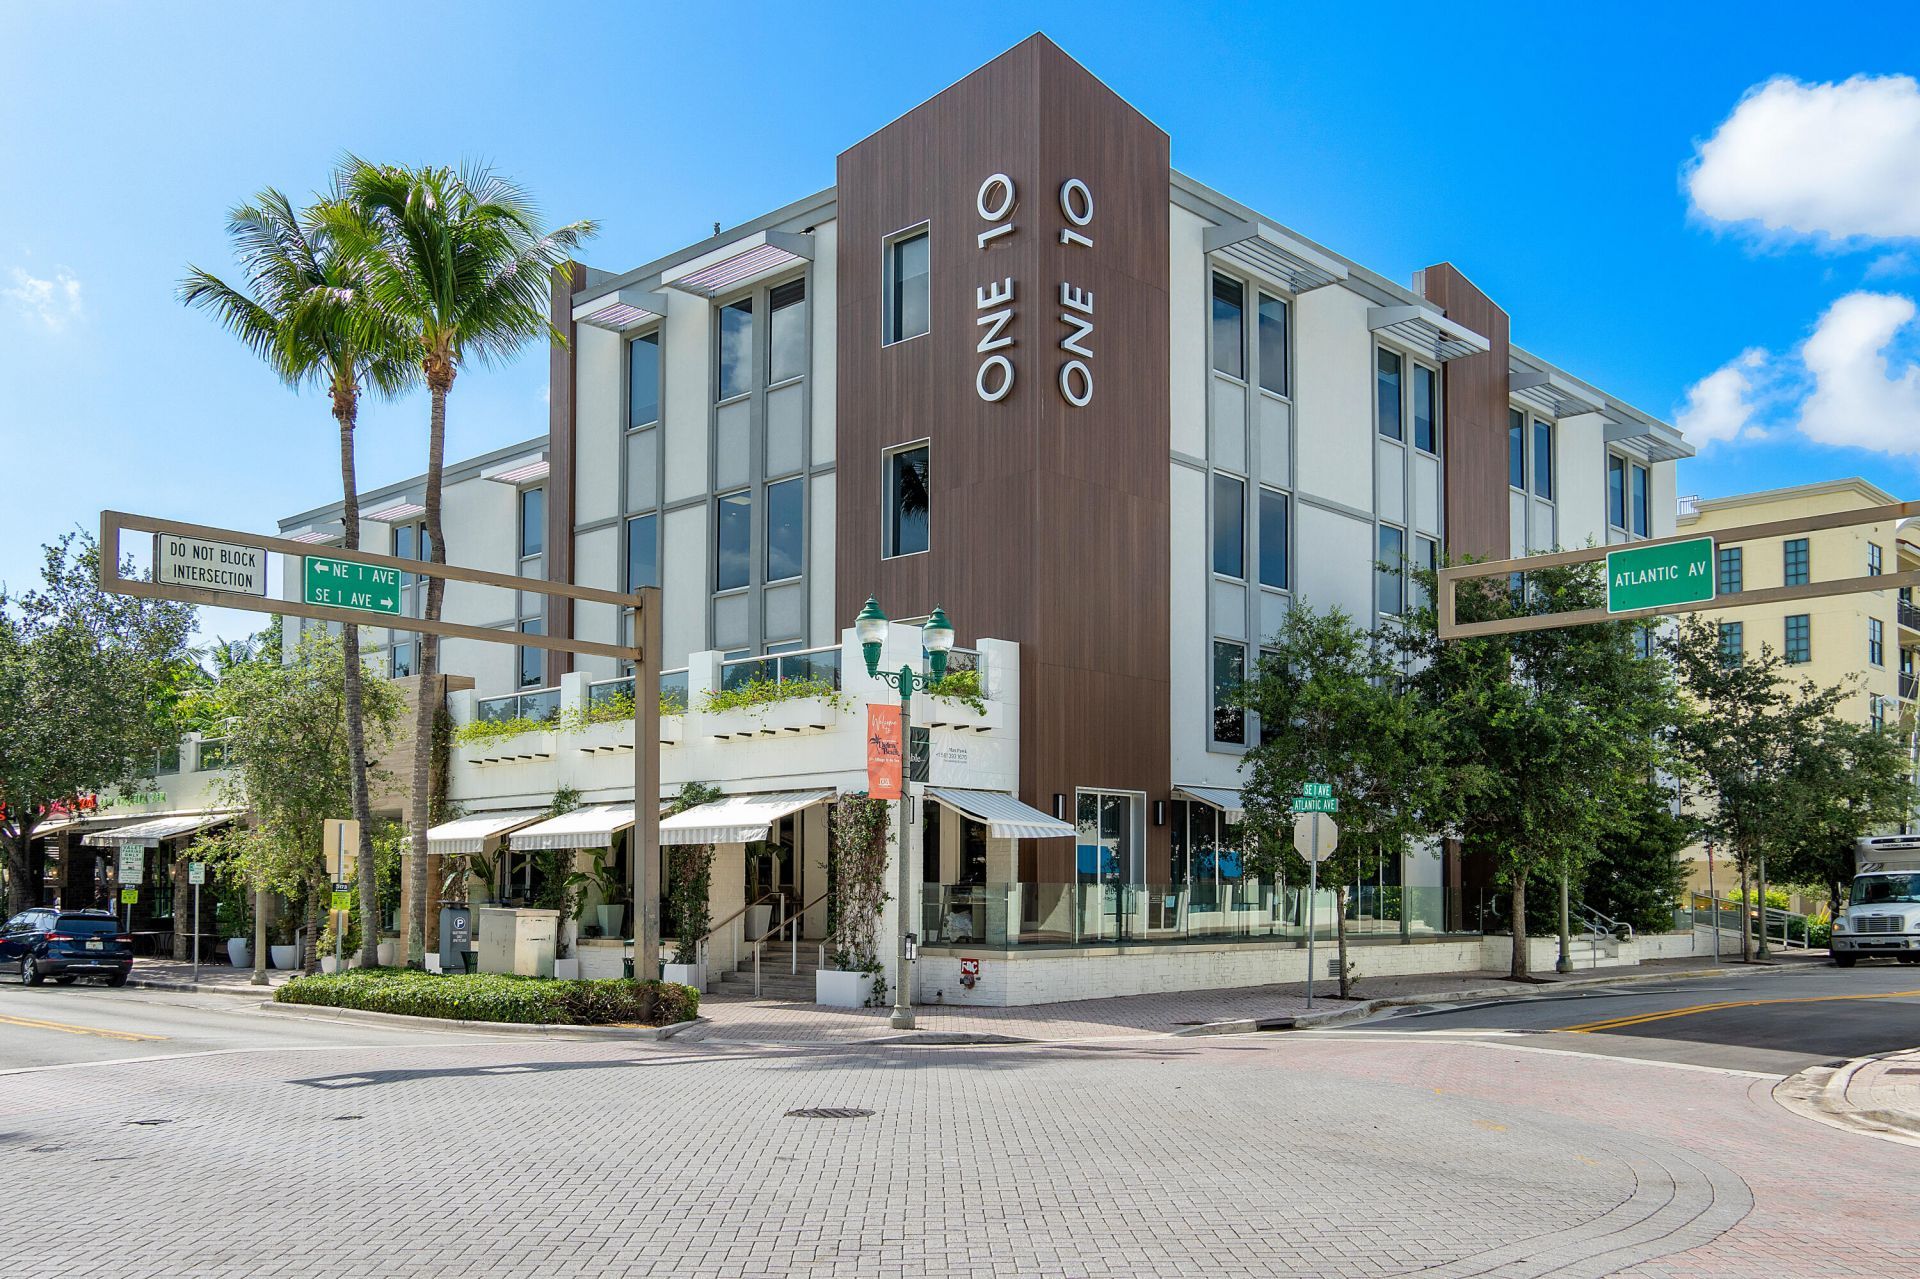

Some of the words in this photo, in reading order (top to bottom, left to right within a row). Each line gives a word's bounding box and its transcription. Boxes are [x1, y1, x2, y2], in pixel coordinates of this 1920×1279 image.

[976, 173, 1015, 249] 10
[1059, 178, 1094, 248] 10
[976, 277, 1015, 402] ONE
[1059, 281, 1094, 407] ONE
[170, 542, 186, 557] DO
[193, 545, 214, 561] NOT
[220, 549, 255, 568] BLOCK
[173, 564, 252, 588] INTERSECTION
[333, 563, 349, 578] NE
[358, 567, 363, 580] 1
[372, 569, 395, 585] AVE
[1615, 565, 1678, 587] ATLANTIC
[1688, 561, 1706, 577] AV
[315, 588, 330, 602] SE
[338, 590, 342, 603] 1
[350, 592, 372, 607] AVE
[1305, 784, 1312, 795] SE
[1318, 785, 1330, 796] AVE
[1294, 799, 1321, 811] ATLANTIC
[1323, 799, 1335, 810] AVE
